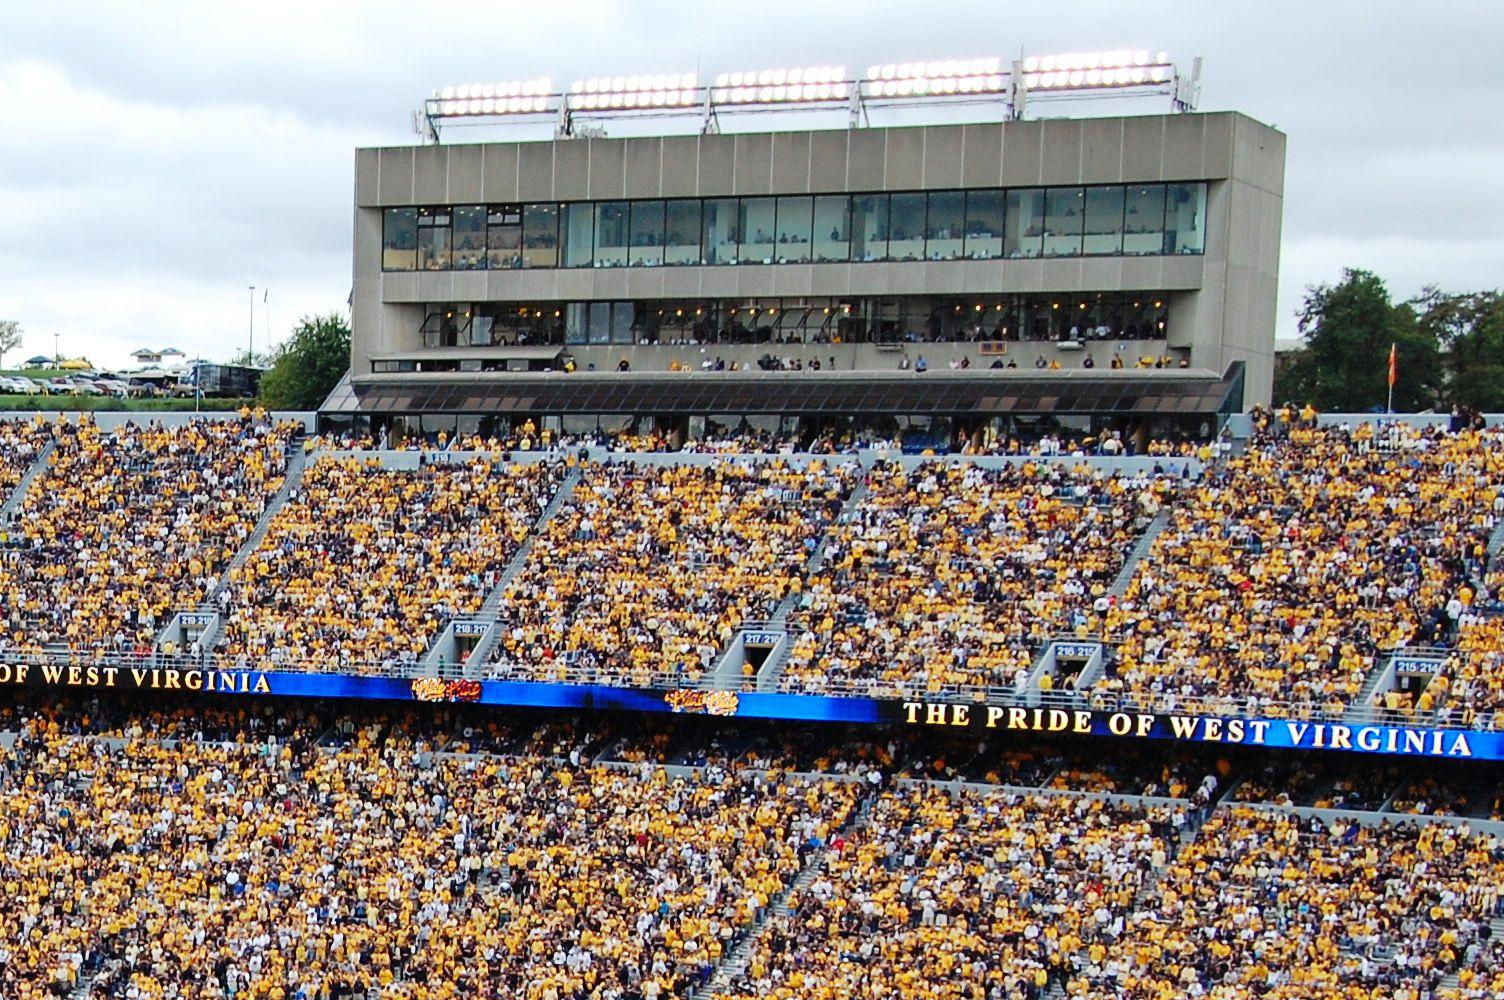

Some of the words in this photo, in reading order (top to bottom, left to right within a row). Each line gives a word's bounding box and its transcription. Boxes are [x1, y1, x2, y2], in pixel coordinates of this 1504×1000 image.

[746, 635, 761, 643] 217
[1398, 662, 1416, 672] 215
[1420, 663, 1438, 672] 214
[42, 665, 120, 687] WEST
[134, 668, 271, 693] VIRGINIA
[902, 702, 970, 726] THE
[987, 705, 1093, 733] PRIDE
[1109, 713, 1155, 737] OF
[1170, 716, 1269, 744] WEST
[1287, 721, 1473, 757] VIRGINIA
